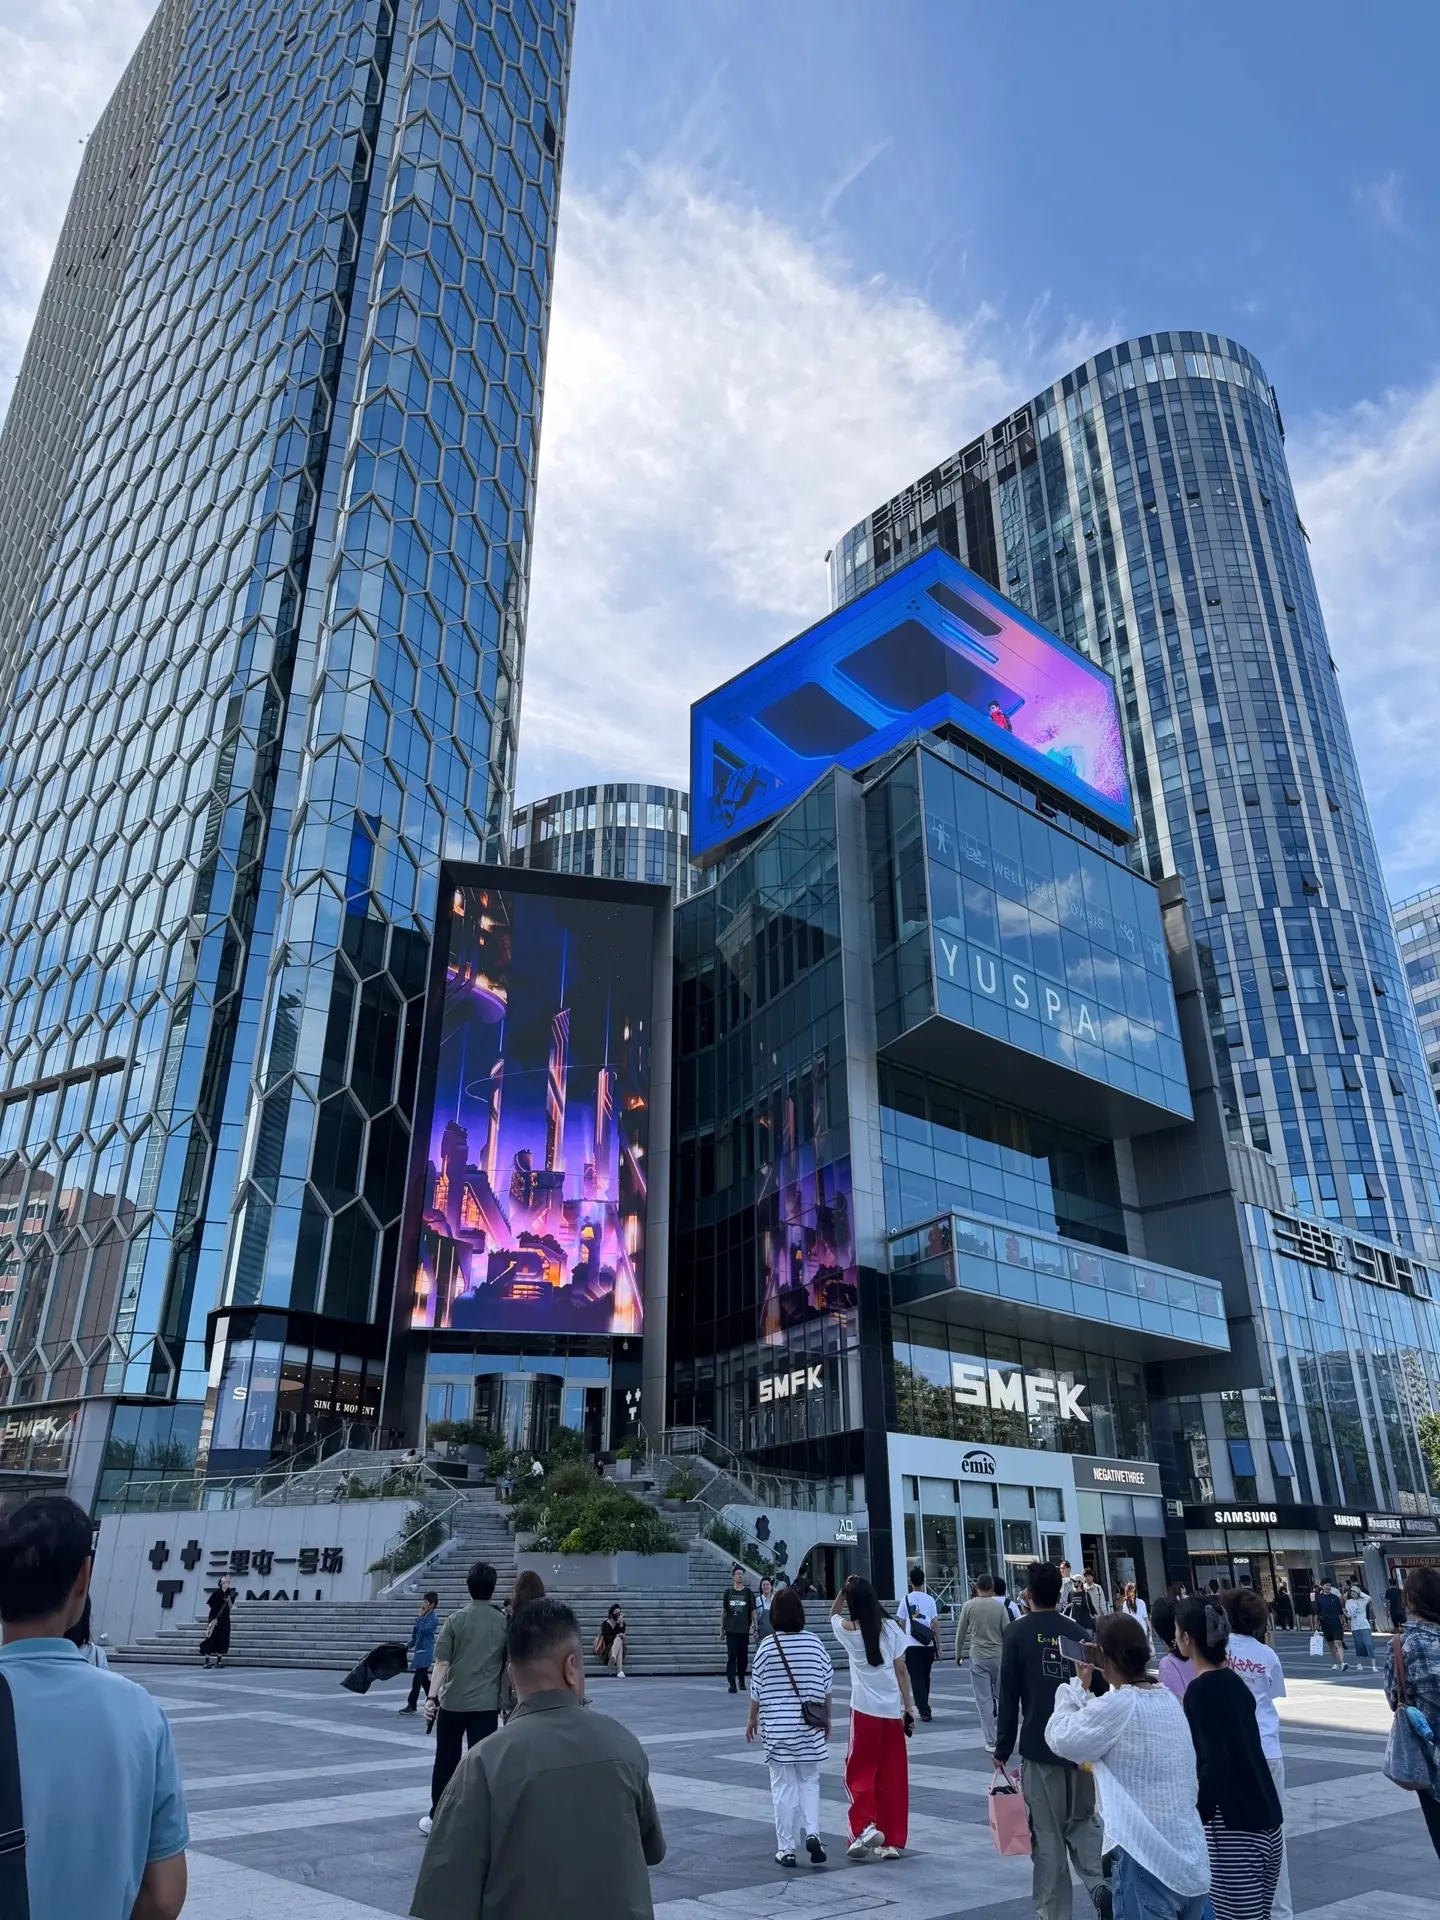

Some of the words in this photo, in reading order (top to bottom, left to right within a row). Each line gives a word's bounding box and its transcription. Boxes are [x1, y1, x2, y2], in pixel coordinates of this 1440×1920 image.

[872, 479, 936, 537] 三里屯
[939, 409, 1030, 490] SOHO
[993, 861, 1056, 903] WELLNESS
[1070, 903, 1105, 930] OASIS
[1272, 1210, 1347, 1275] 三里屯
[1352, 1238, 1433, 1301] SOHO
[759, 1364, 823, 1403] SMFK
[952, 1361, 1090, 1423] SMFK
[313, 1399, 341, 1412] SINE
[961, 1456, 996, 1475] emis
[1093, 1467, 1145, 1485] NEGATIVETHREE
[1214, 1511, 1278, 1523] SAMSUNG
[1333, 1514, 1362, 1527] SAMSUNG
[205, 1547, 344, 1577] 三里屯一号场
